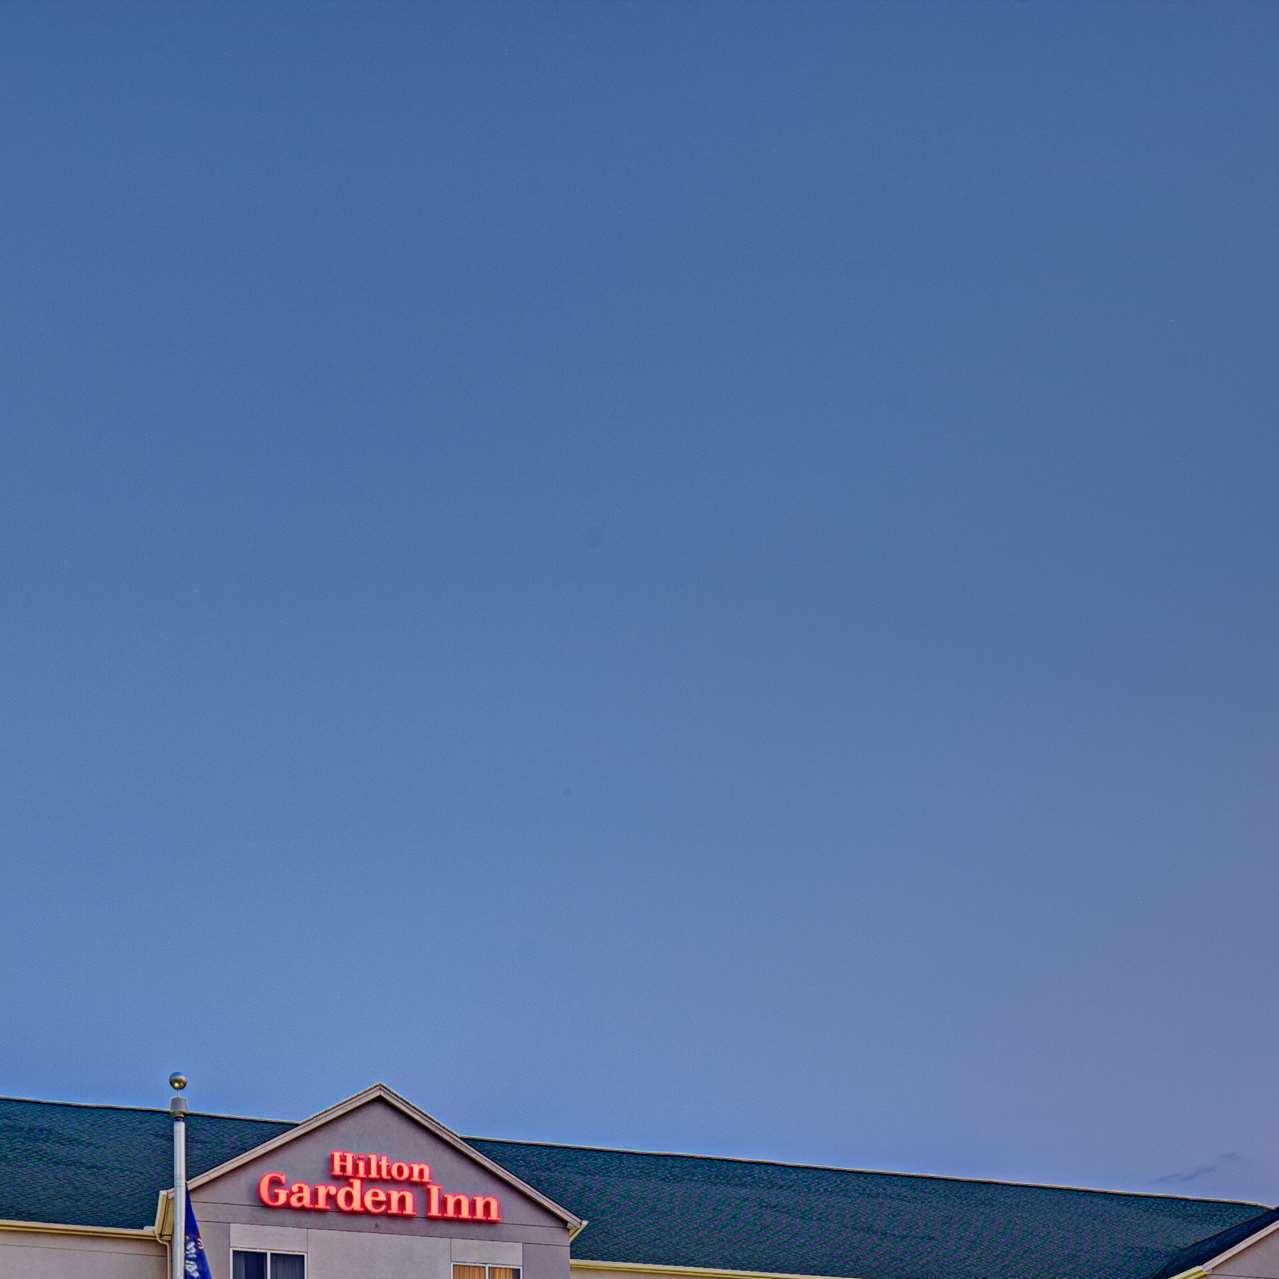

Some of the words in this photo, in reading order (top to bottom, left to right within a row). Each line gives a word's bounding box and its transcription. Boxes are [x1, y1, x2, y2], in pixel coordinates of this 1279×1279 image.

[330, 1151, 432, 1183] Hilton
[258, 1171, 417, 1216] Garden
[426, 1184, 502, 1222] Inn
